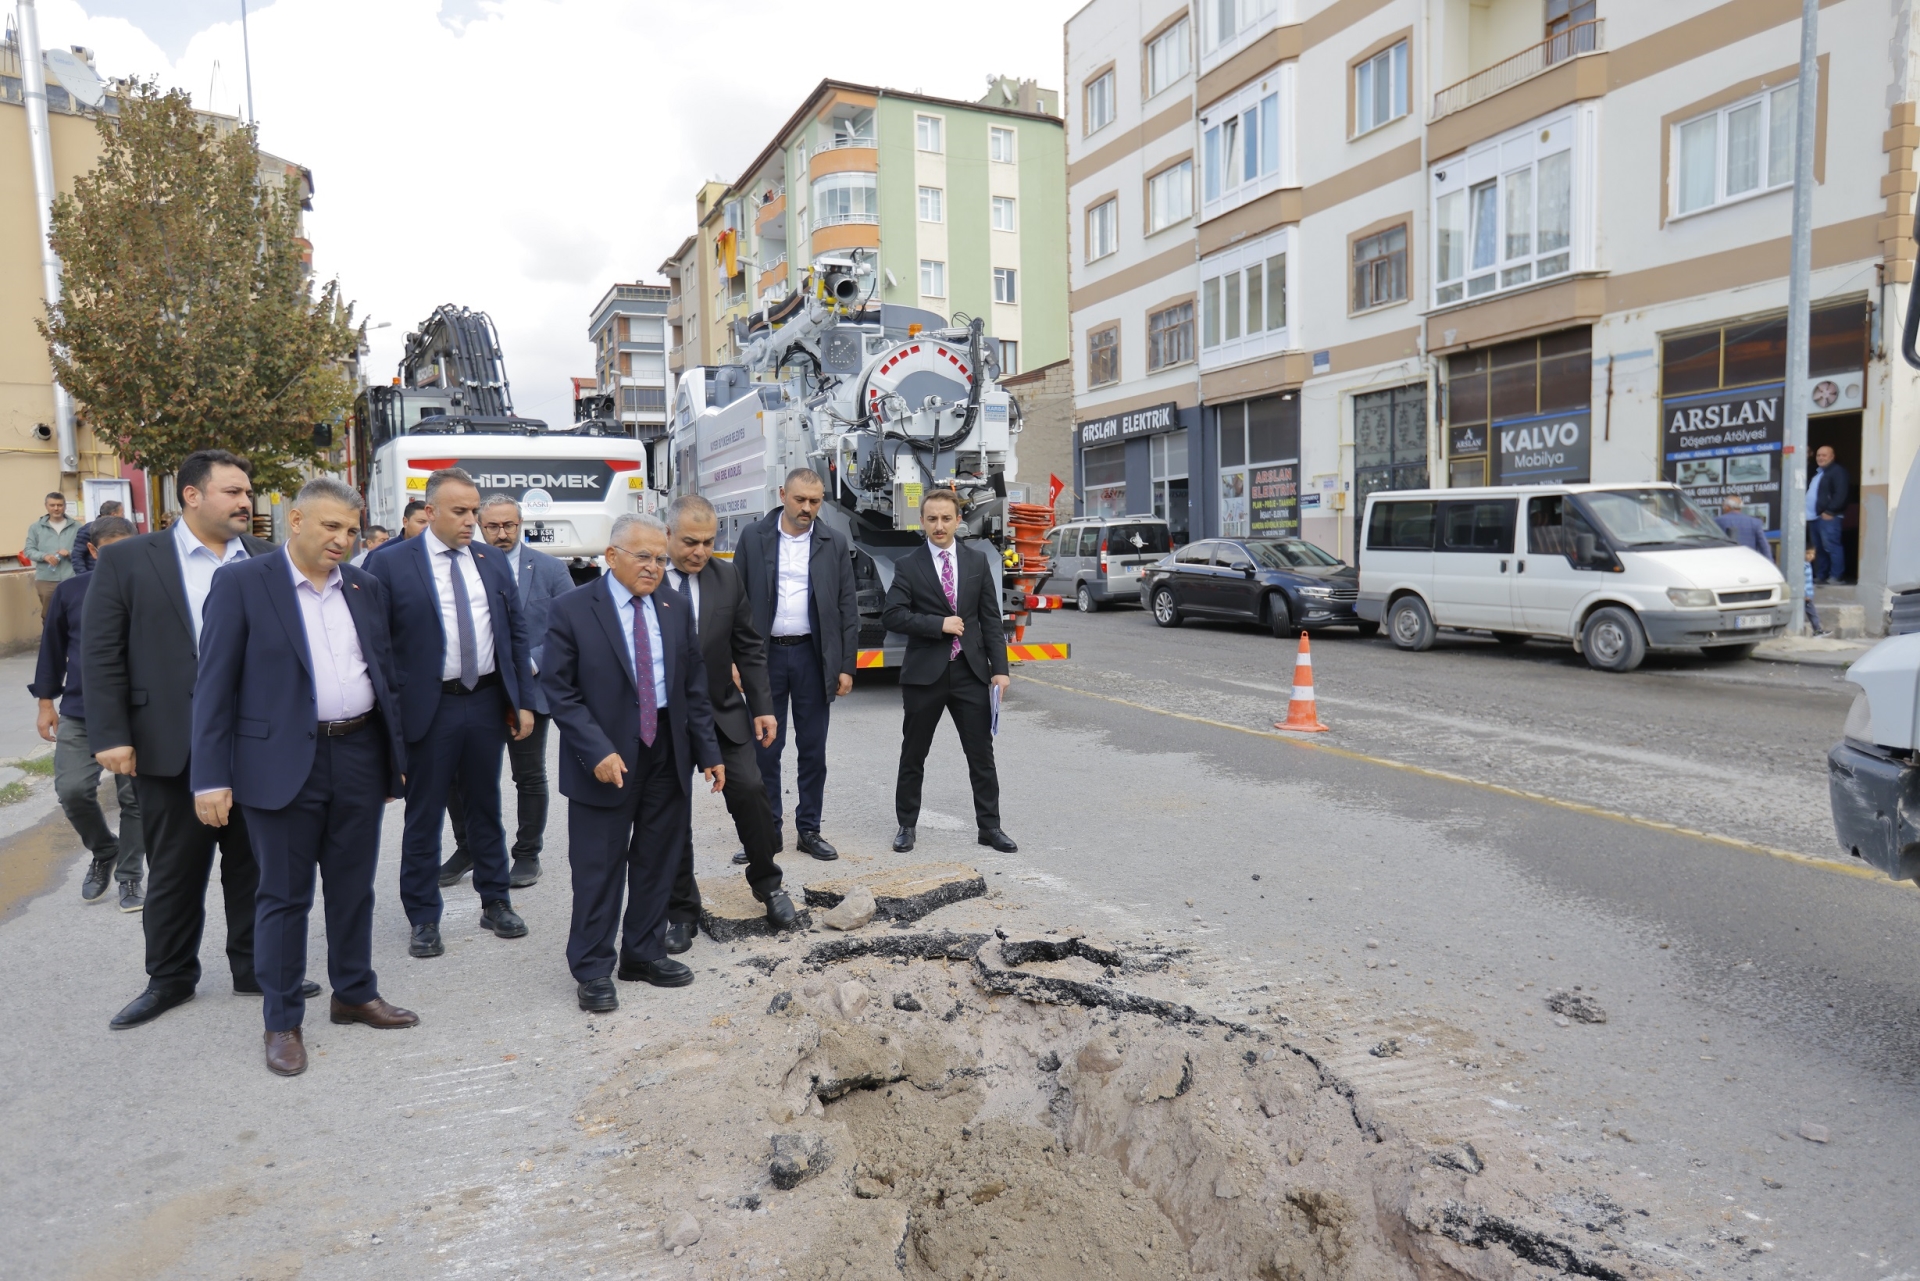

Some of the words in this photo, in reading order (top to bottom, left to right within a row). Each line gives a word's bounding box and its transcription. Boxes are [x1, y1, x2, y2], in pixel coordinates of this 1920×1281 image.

[1082, 419, 1117, 443] ARSLAN
[1122, 407, 1170, 434] ELEKTRİK
[1669, 398, 1778, 433] ARSLAN
[1501, 422, 1579, 453] KALVO
[1680, 434, 1722, 448] Döşeme
[1723, 427, 1767, 443] Atölyesi
[1514, 452, 1564, 468] Mobilya
[1255, 467, 1293, 484] ARSLAN
